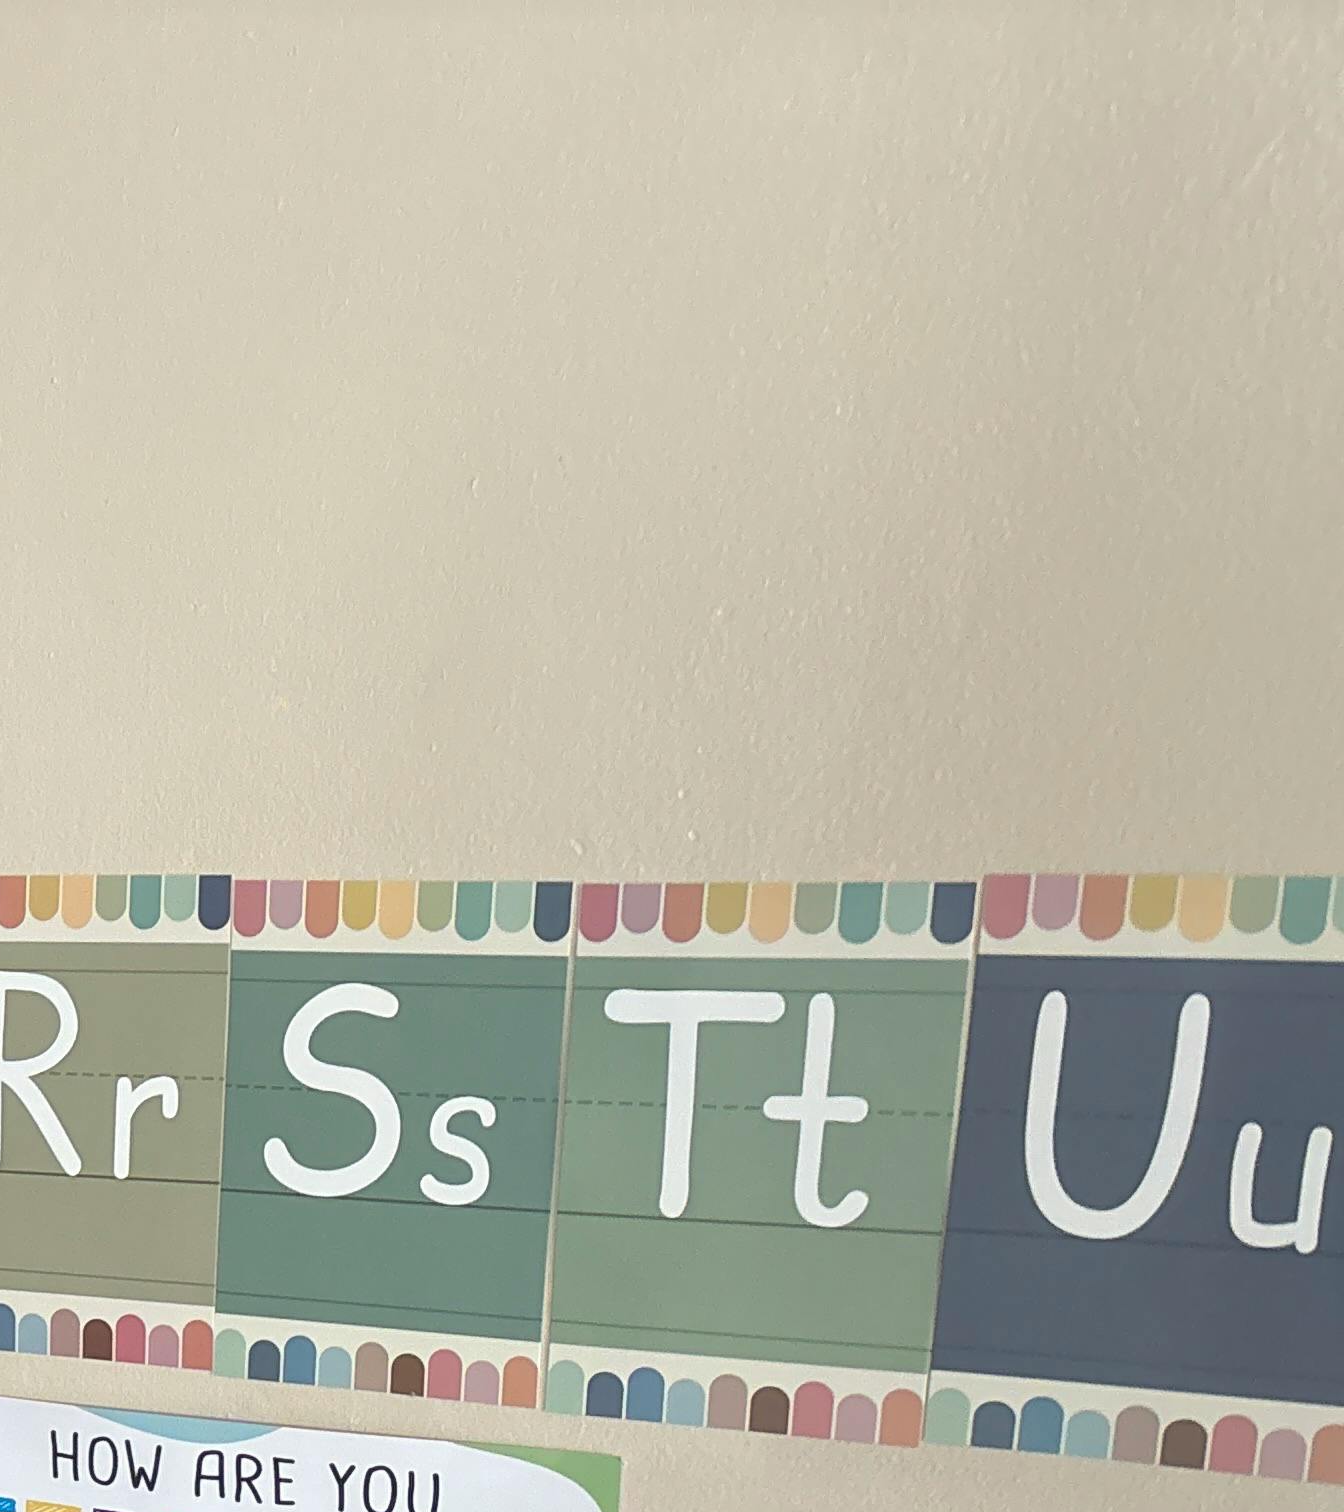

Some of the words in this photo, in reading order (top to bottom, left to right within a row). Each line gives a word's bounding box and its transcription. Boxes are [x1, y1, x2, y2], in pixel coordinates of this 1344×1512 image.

[263, 982, 497, 1206] Ss
[604, 989, 869, 1228] Tt
[1024, 990, 1333, 1254] Uu
[50, 1429, 161, 1492] HOW
[194, 1450, 296, 1505] ARE
